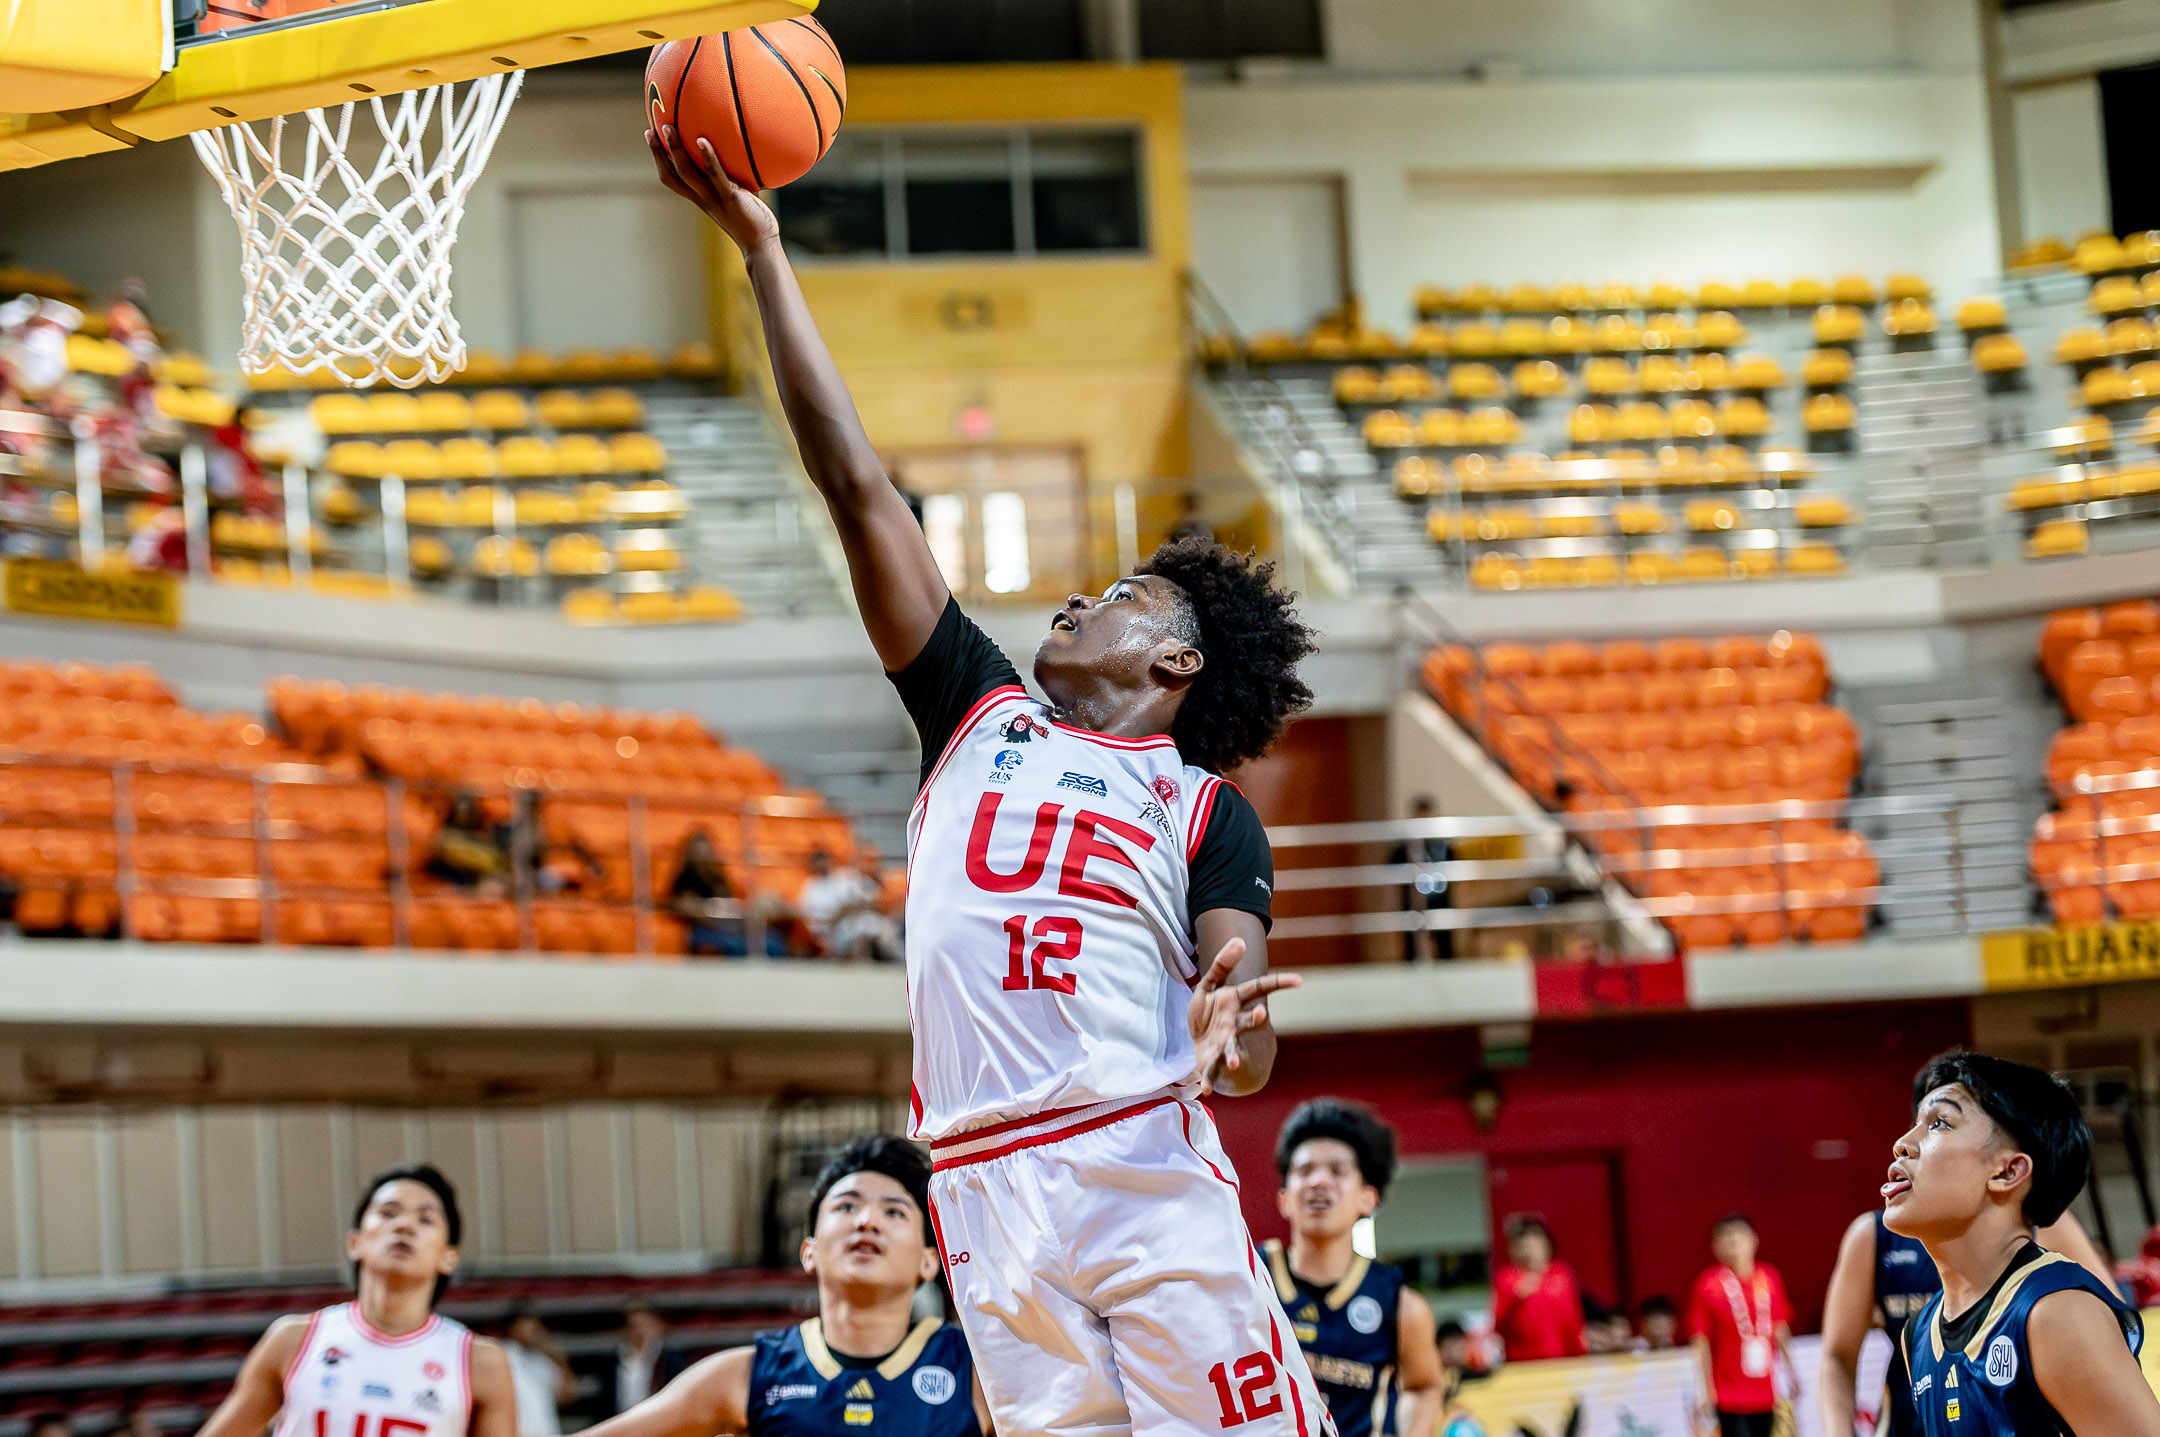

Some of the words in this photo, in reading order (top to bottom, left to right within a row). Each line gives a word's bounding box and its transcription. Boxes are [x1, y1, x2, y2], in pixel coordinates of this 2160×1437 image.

[988, 771, 1013, 781] ZUS
[1056, 781, 1107, 797] STRONG
[965, 791, 1157, 910] UE
[1002, 914, 1083, 995] 12
[1208, 1351, 1283, 1429] 12
